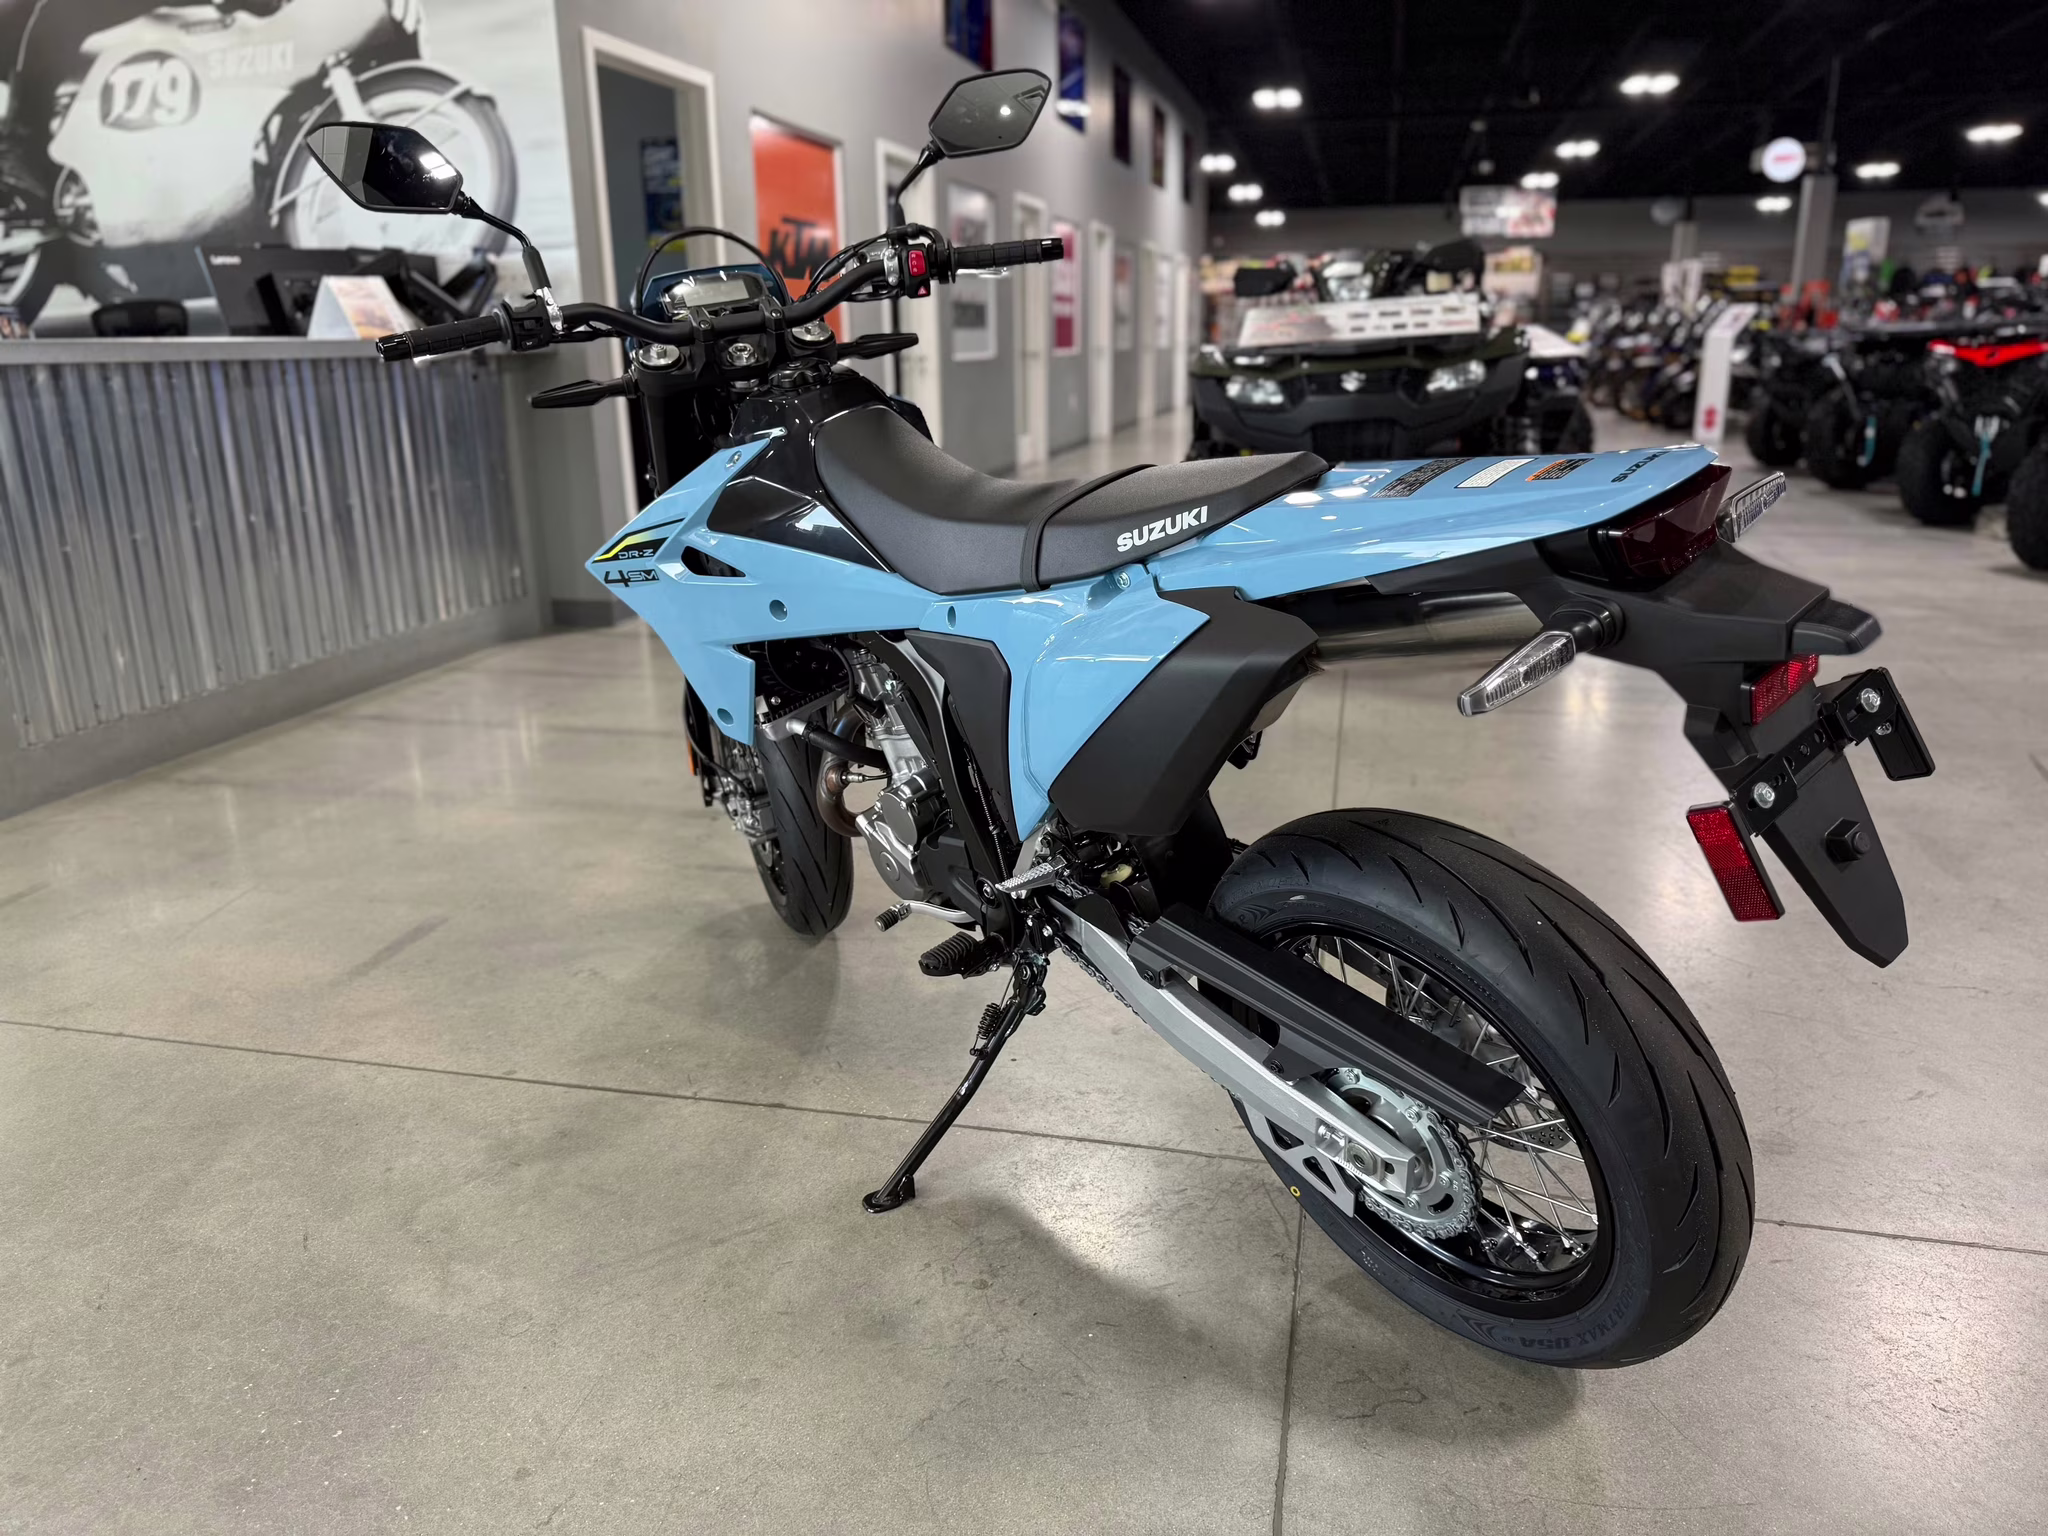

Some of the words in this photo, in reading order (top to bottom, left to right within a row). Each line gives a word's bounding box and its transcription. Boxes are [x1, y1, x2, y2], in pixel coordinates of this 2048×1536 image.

[106, 57, 192, 127] 179
[765, 216, 831, 281] KTM
[1611, 451, 1671, 483] SUZUKI
[1116, 505, 1208, 552] SUZUKI
[618, 548, 654, 559] DR-Z
